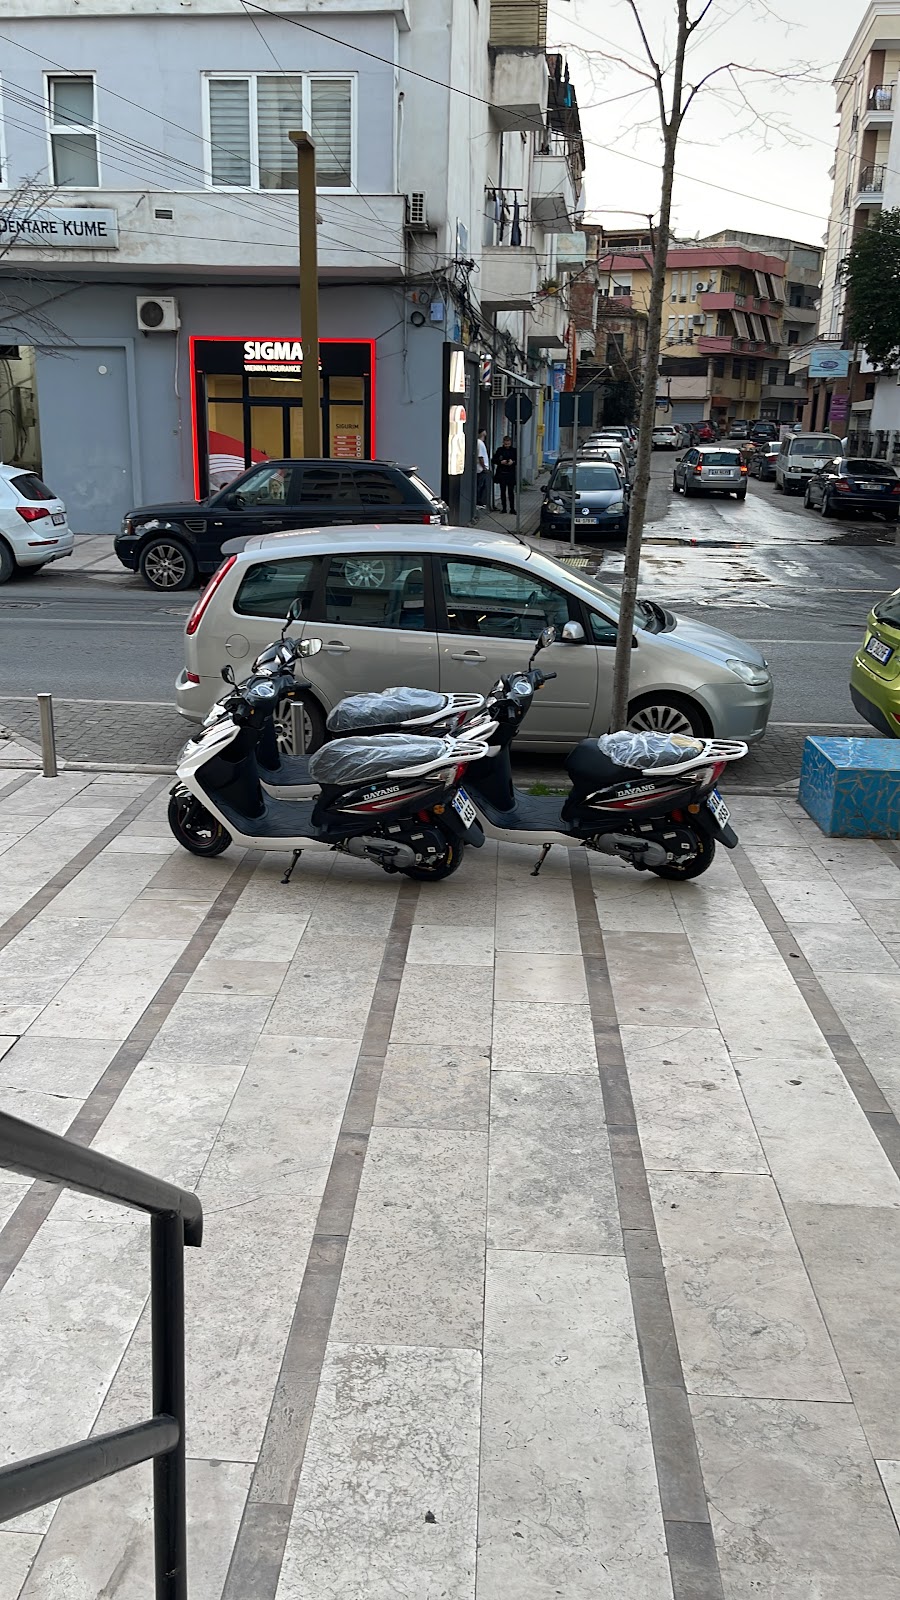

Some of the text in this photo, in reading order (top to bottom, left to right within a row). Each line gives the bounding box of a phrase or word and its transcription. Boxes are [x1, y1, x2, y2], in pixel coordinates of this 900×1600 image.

[0, 218, 108, 237] DENTARE KUME
[243, 341, 304, 360] SIGMA
[363, 785, 400, 801] DAYANG
[617, 783, 655, 798] DAYANG
